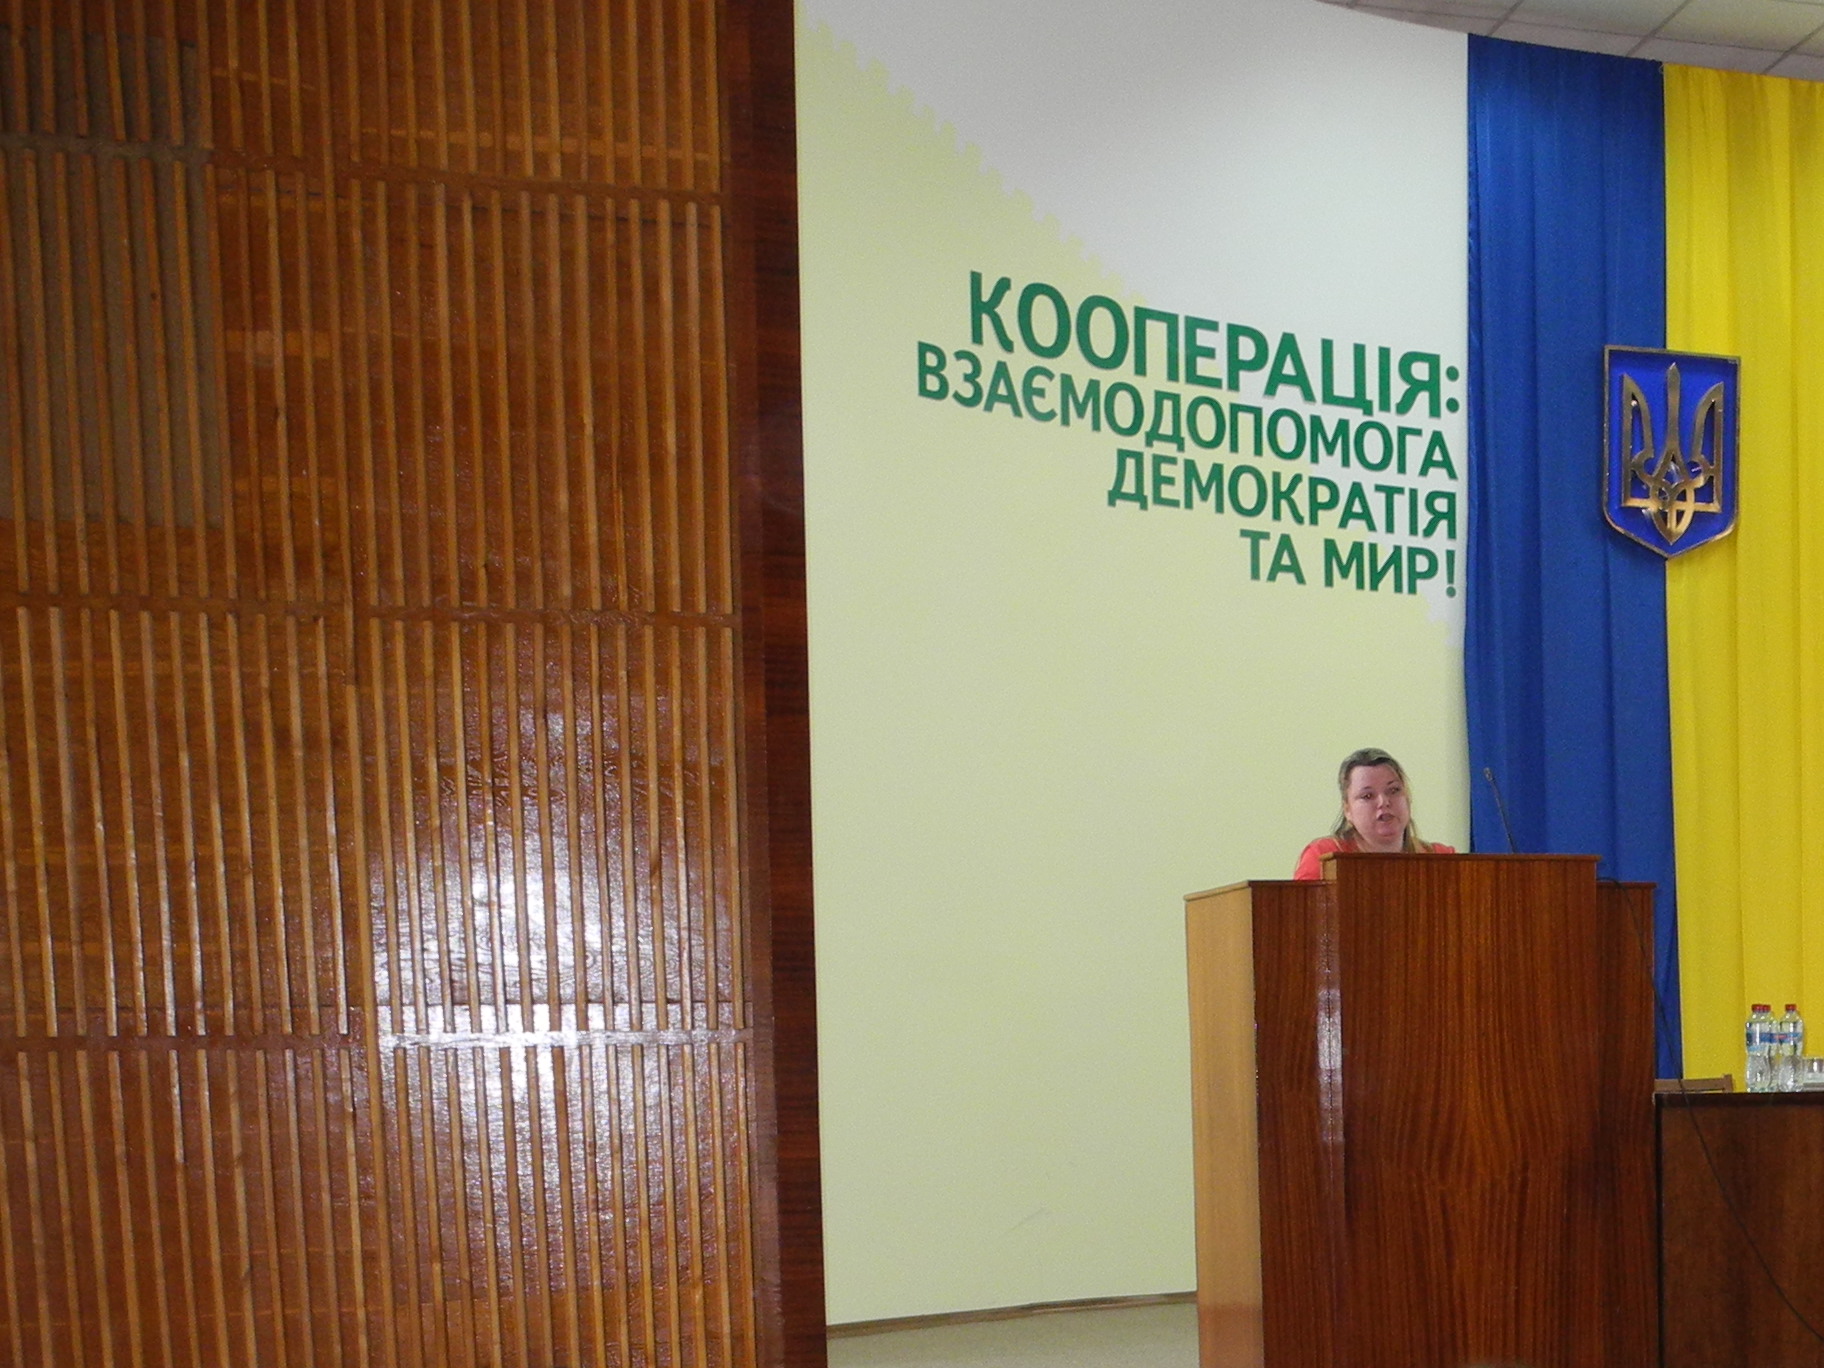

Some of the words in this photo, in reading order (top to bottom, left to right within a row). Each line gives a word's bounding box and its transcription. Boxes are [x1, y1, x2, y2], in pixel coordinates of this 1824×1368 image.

[970, 270, 1460, 419] КООПЕРАЦІЯ:
[917, 341, 1458, 480] ВЗАЄМОДОПОМОГА
[1107, 448, 1457, 540] ДЕМОКРАТІЯ
[1240, 529, 1306, 585] ТА
[1323, 538, 1457, 598] МИР!
